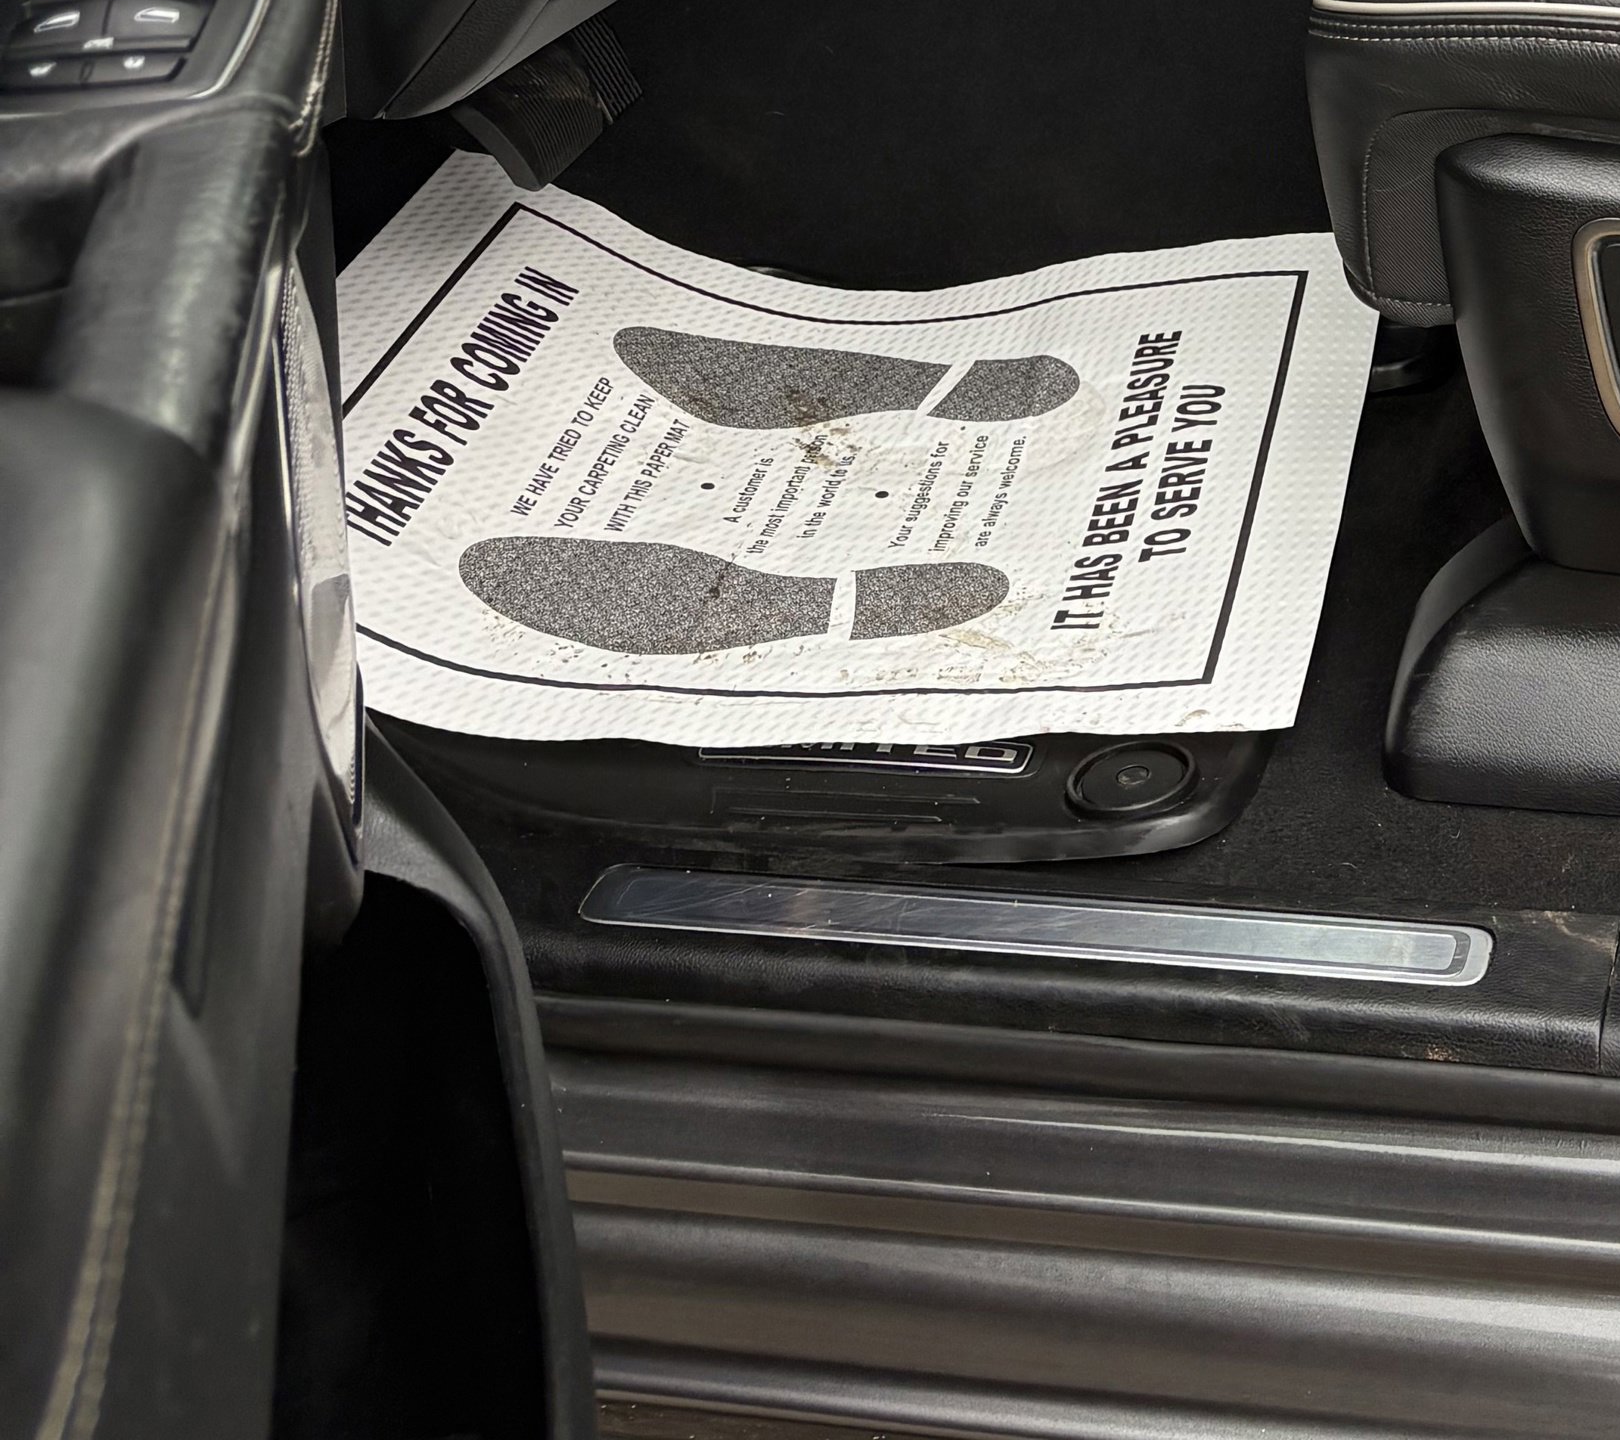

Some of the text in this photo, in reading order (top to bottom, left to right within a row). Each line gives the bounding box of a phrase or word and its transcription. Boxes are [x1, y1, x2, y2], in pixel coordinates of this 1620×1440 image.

[345, 266, 580, 547] THANKS FOR COMING IN
[510, 376, 614, 516] WE HAVE TRIED TO KEEP
[554, 394, 655, 528] YOUR CARPETING CLEAN
[603, 418, 690, 532] WITH THIS PAPER MAT
[723, 457, 774, 524] A customer is
[770, 466, 811, 512] important
[817, 479, 842, 508] world
[830, 468, 848, 479] to
[888, 441, 950, 549] Your suggestions for
[928, 435, 989, 552] improving our service
[975, 435, 1027, 547] are always welcome.
[1050, 330, 1183, 631] IT HAS BEEN A PLEASURE
[1138, 384, 1226, 562] TO SERVE YOU
[746, 539, 768, 554] the
[760, 514, 785, 537] most
[796, 529, 817, 538] in
[805, 511, 826, 527] the
